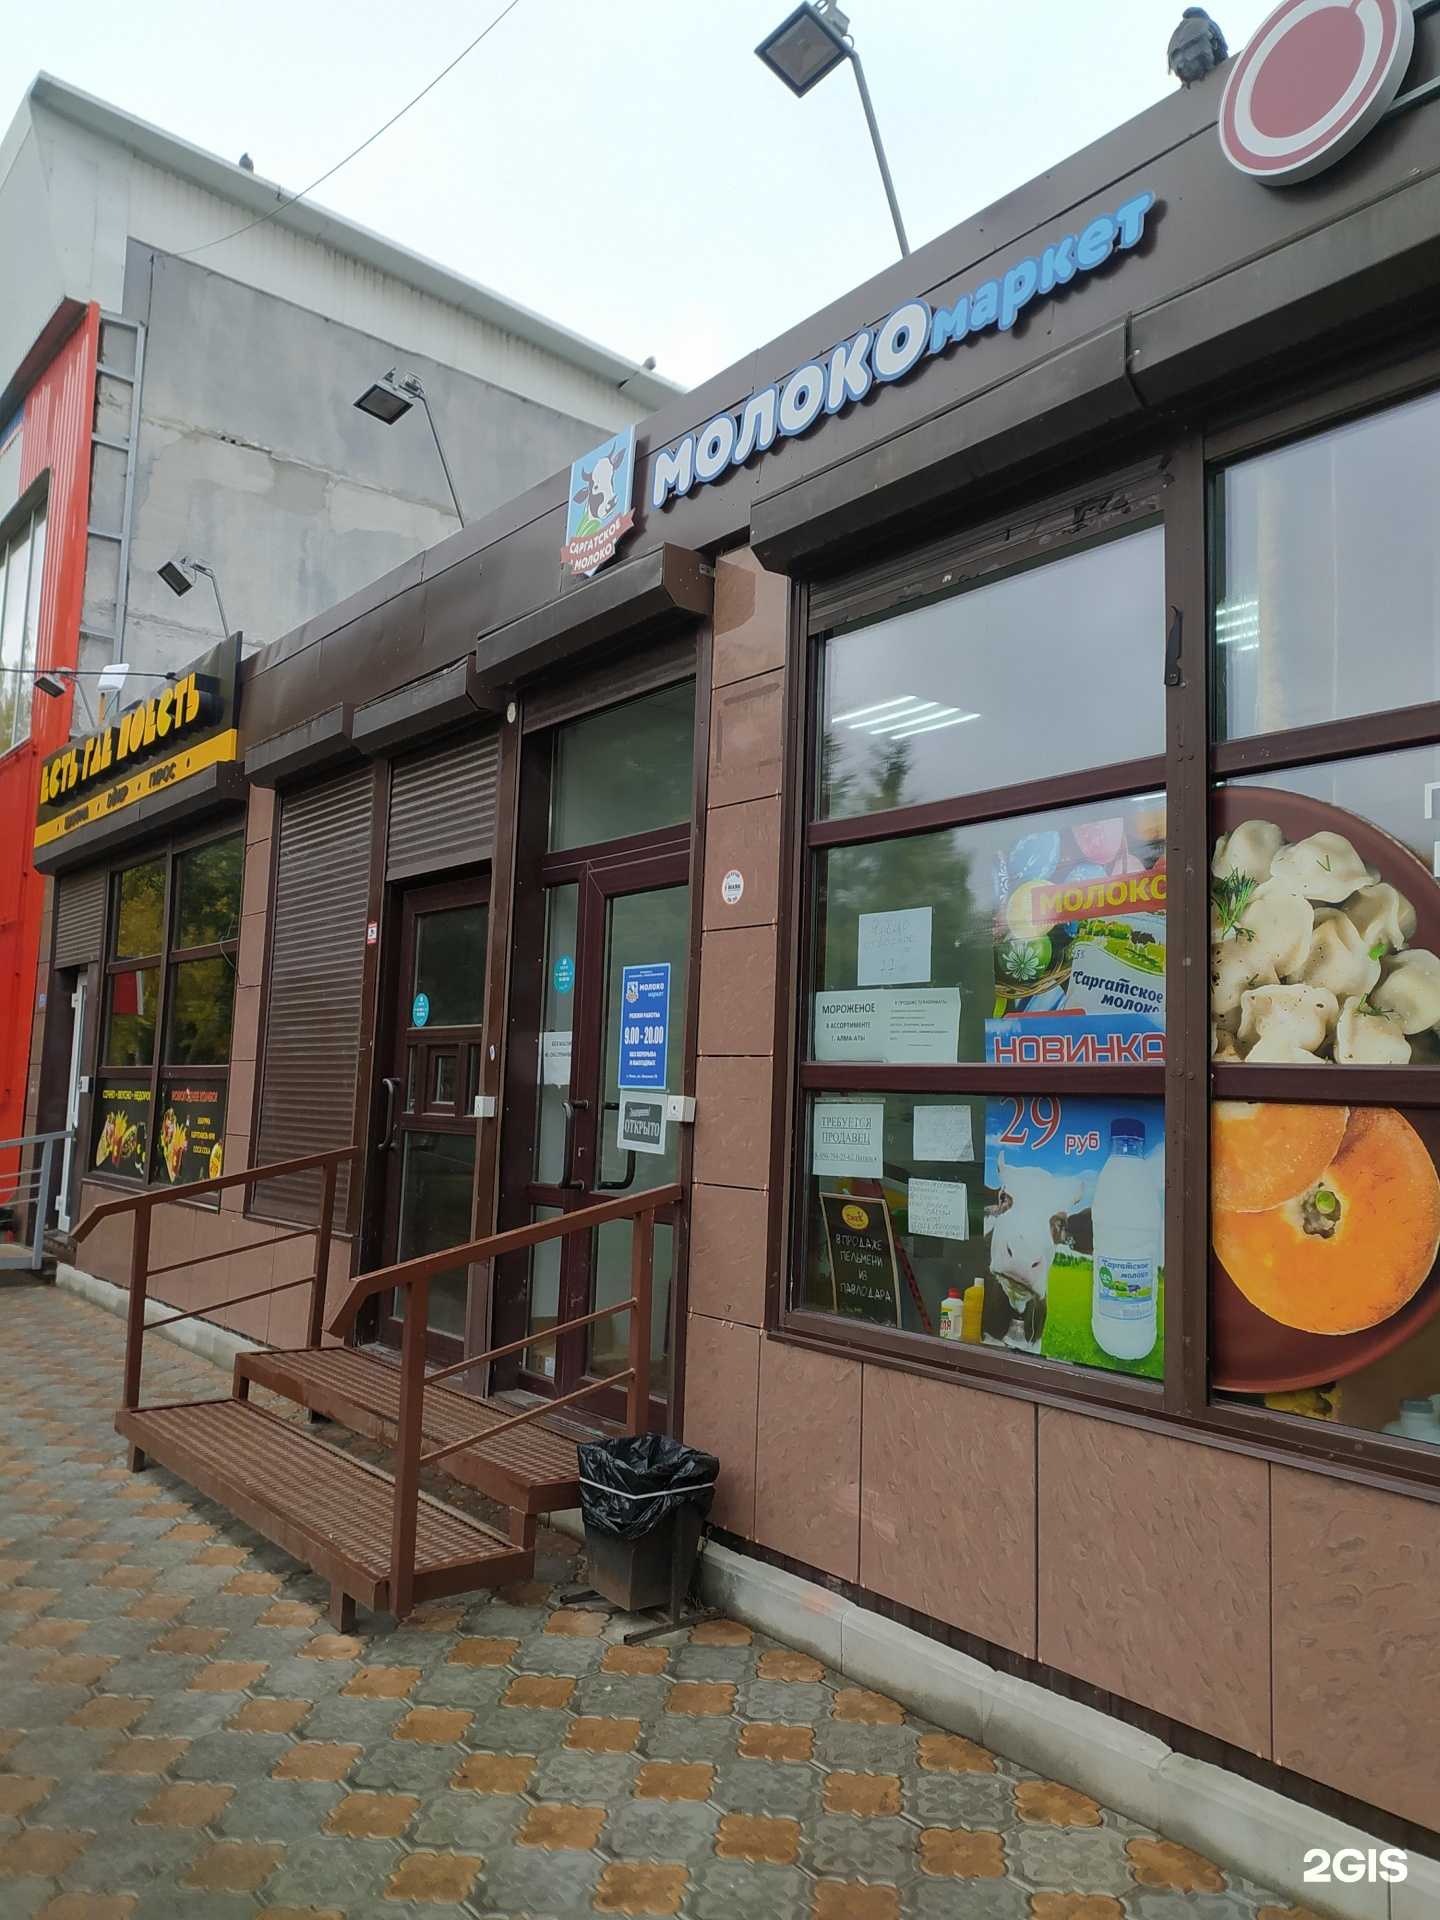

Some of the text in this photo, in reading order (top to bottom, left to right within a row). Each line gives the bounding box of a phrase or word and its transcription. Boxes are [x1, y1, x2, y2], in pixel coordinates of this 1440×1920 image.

[569, 517, 621, 555] САРГАТСКОЕ
[573, 543, 612, 571] МОЛОКО
[39, 748, 78, 804] ЕСТЬ
[81, 727, 112, 781] ГДЕ
[116, 671, 200, 761] ПОЕСТЬ
[1072, 970, 1164, 1003] Саргатское
[822, 1002, 876, 1015] МОРОЖЕНОЕ
[994, 1031, 1167, 1063] НОВИНКА
[624, 1119, 660, 1137] ОТКРЫТО
[821, 1116, 872, 1129] ТРЕБУЕТСЯ
[1000, 1095, 1061, 1150] 29
[1065, 1131, 1100, 1155] руб
[822, 1131, 871, 1146] ПРОДАВЕЦ
[840, 1250, 883, 1268] ПЕЛЬМЕНИ
[840, 1282, 892, 1304] ПАВЛОДАРА
